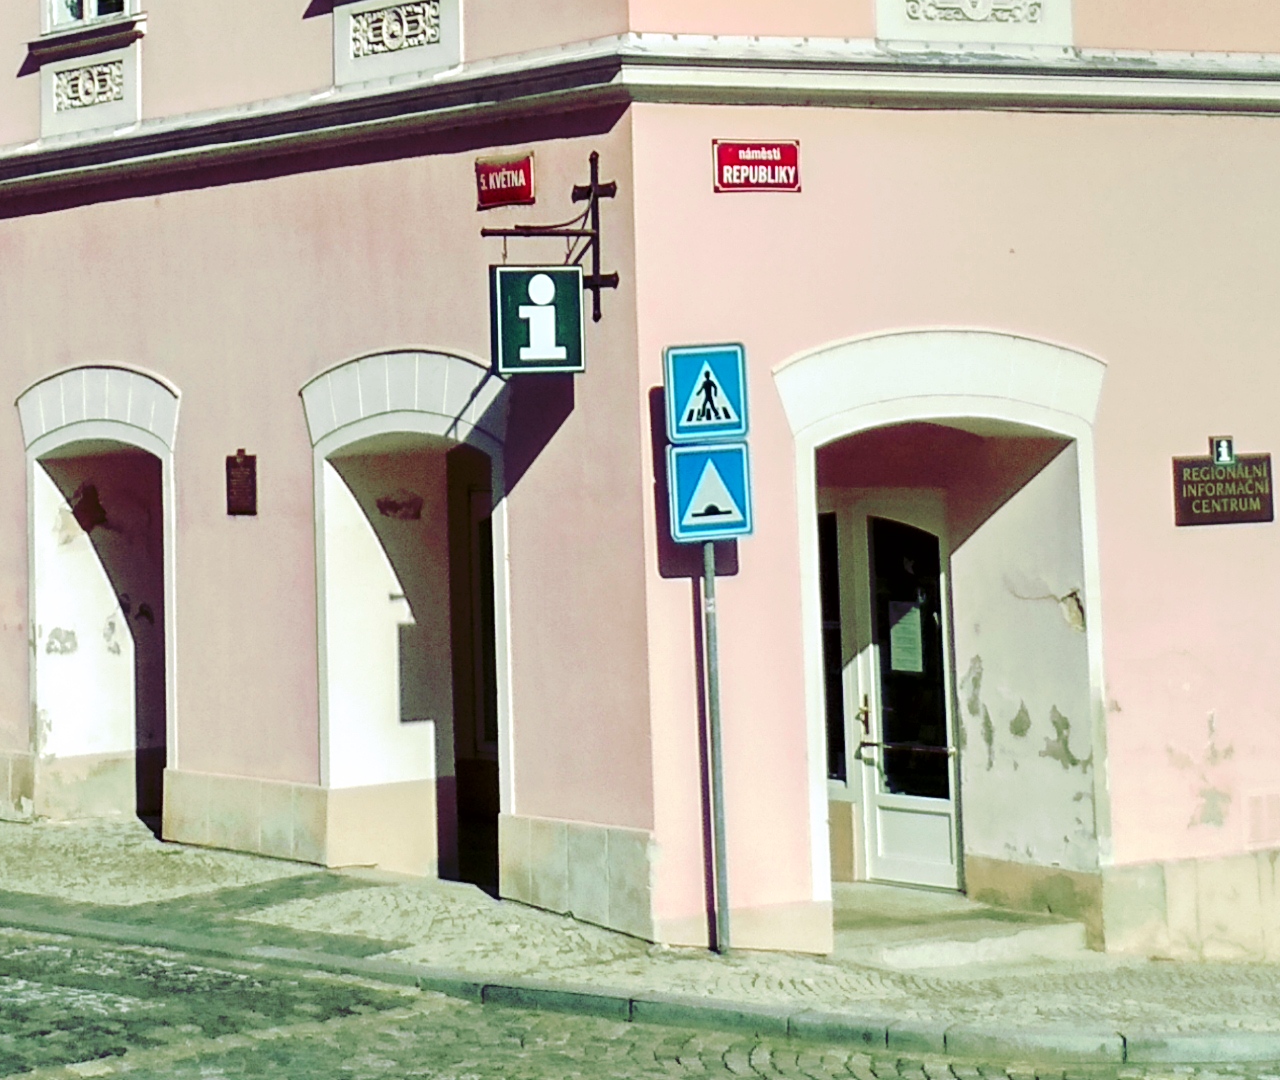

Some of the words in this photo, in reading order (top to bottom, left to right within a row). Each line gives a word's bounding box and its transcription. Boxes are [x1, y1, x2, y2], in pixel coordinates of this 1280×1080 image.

[738, 146, 781, 160] náměstí
[489, 168, 526, 190] KVĚTNA
[723, 165, 795, 184] REPUBLIKY
[1183, 461, 1267, 481] REGIONÁLNÍ
[1183, 477, 1269, 497] INFORMAČNÍ
[1192, 497, 1261, 513] CENTRUM
